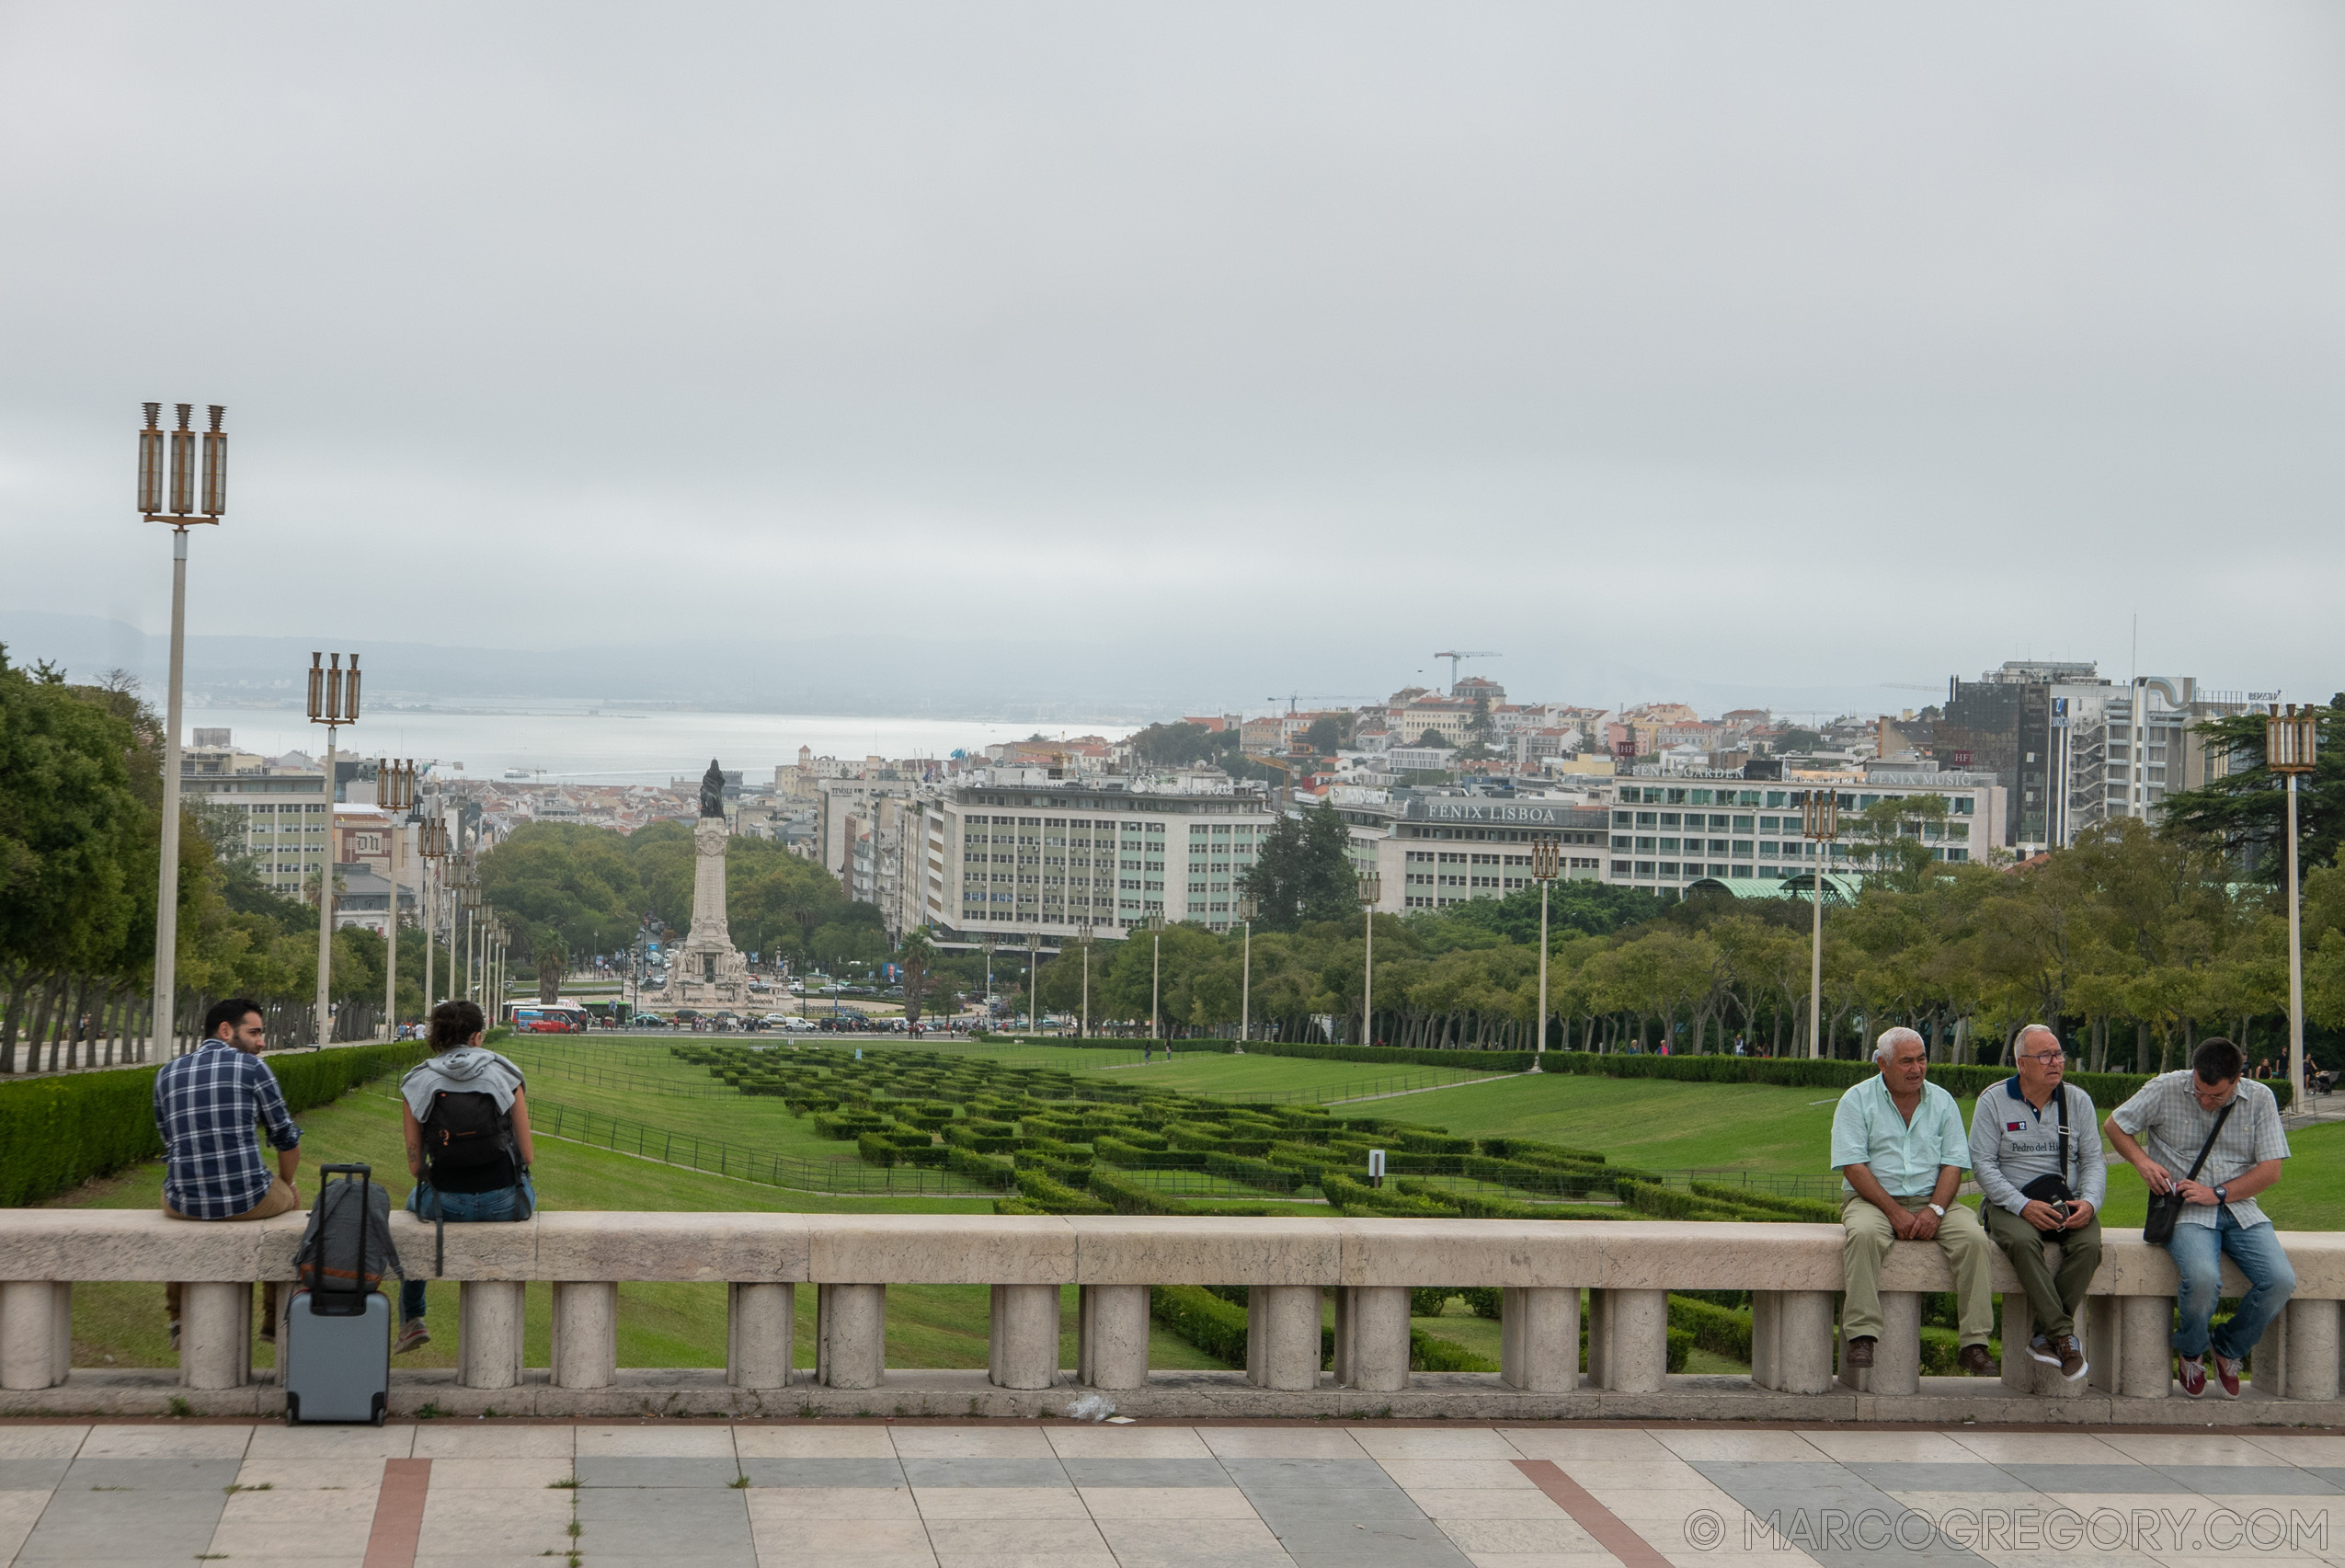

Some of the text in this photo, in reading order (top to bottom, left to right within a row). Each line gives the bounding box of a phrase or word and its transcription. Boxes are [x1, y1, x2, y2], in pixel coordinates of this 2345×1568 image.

[1620, 745, 1634, 753] HF
[1955, 754, 1969, 762] HF
[1684, 766, 1744, 779] GARDEN
[1924, 774, 1971, 786] MUSIC
[831, 786, 852, 795] TIVOLI
[1429, 803, 1555, 821] FÉNIX LISBOA
[2012, 1143, 2034, 1151] Pedro
